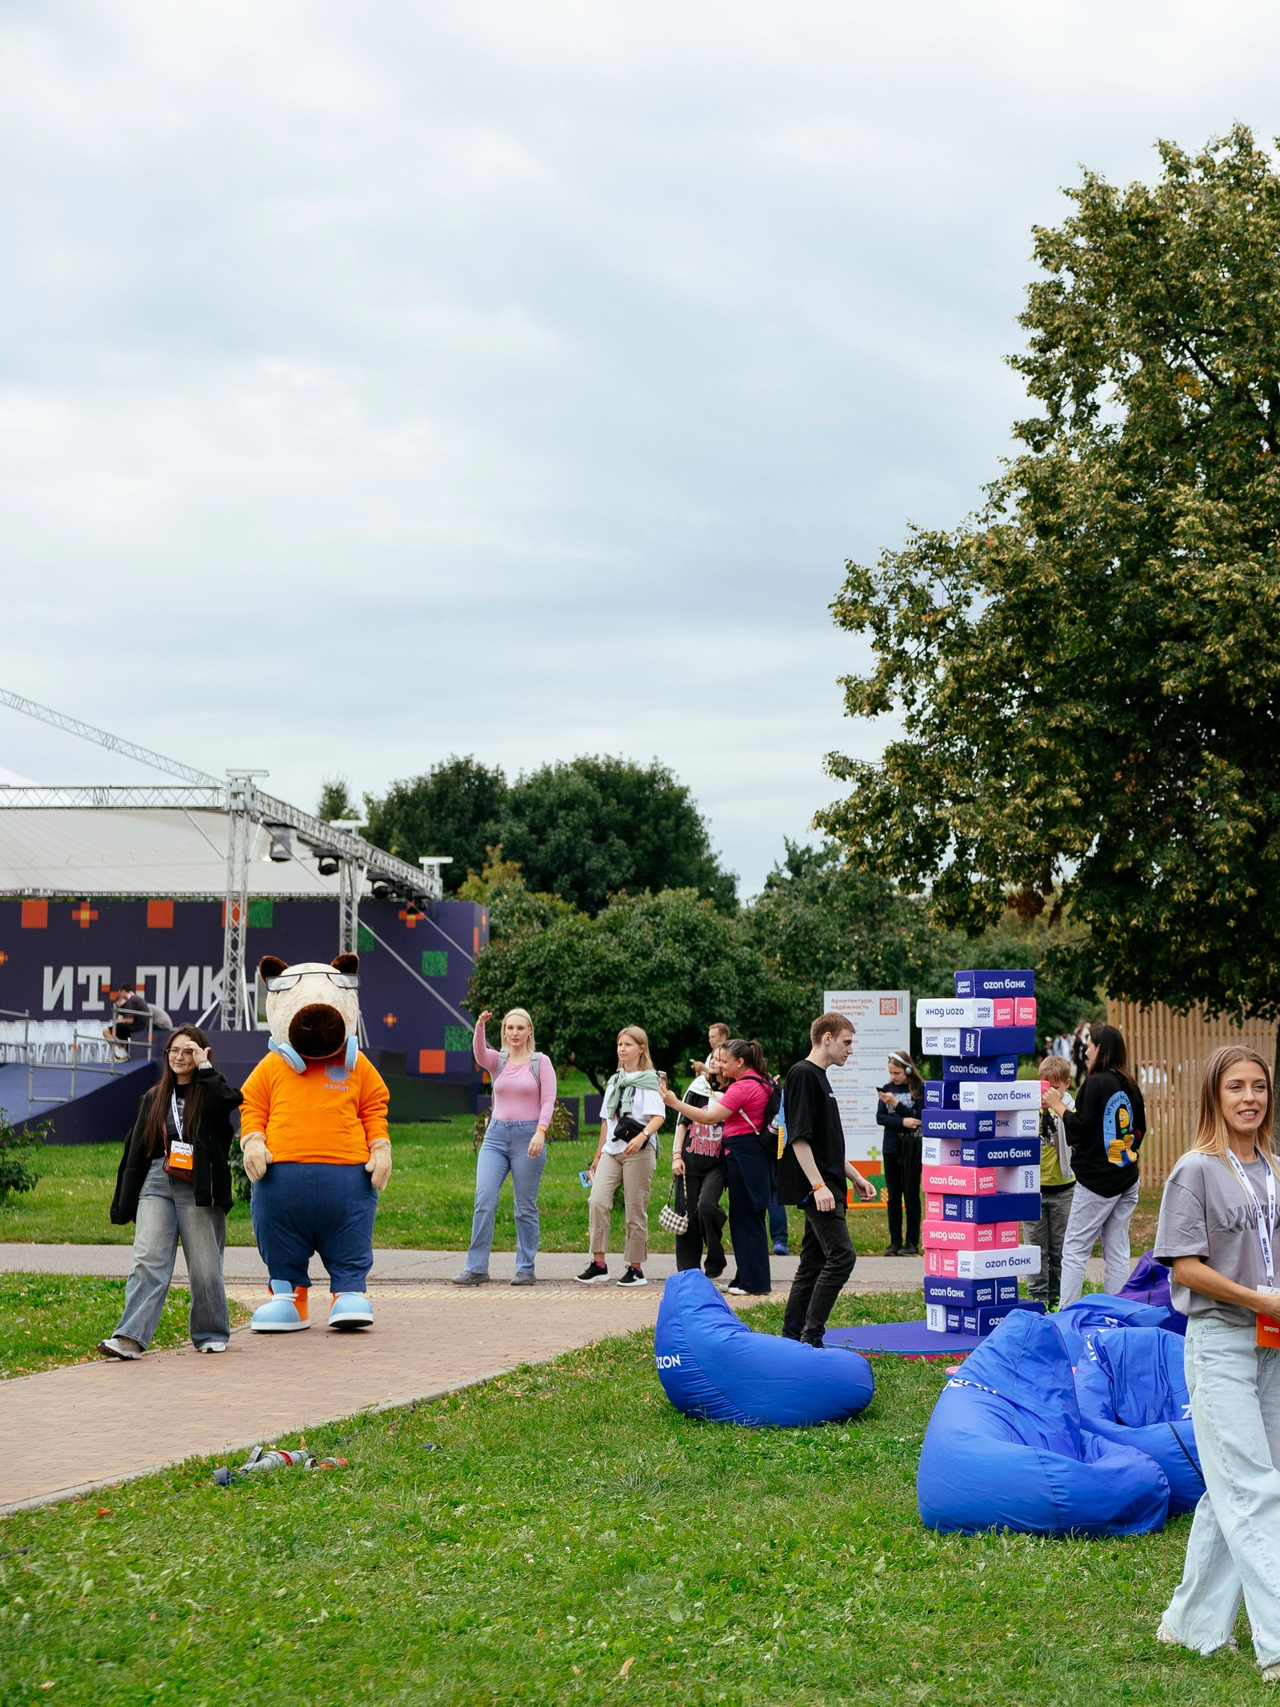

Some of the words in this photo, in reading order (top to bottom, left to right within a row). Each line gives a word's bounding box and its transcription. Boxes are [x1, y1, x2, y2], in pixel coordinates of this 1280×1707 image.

[984, 981, 1004, 989] ozon
[1005, 979, 1026, 988] банк
[926, 1008, 944, 1017] банк
[950, 1064, 968, 1073] ozon
[968, 1064, 988, 1074] банк
[988, 1092, 1008, 1100] ozon
[1010, 1091, 1031, 1100] банк
[928, 1121, 946, 1130] ozon
[947, 1120, 966, 1130] банк
[988, 1150, 1008, 1159] ozon
[1010, 1148, 1032, 1158] банк
[930, 1176, 948, 1185] ozon
[948, 1176, 966, 1187] банк
[930, 1231, 947, 1241] банк
[948, 1232, 966, 1240] ozon
[985, 1260, 1006, 1268] ozon
[1008, 1257, 1031, 1267] банк
[944, 1264, 954, 1272] банк
[930, 1288, 946, 1296] ozon
[946, 1287, 964, 1298] банк
[976, 1294, 992, 1302] банк
[948, 1320, 958, 1328] банк
[964, 1322, 976, 1330] банк
[1264, 1325, 1280, 1333] ПРОМО
[656, 1354, 681, 1369] ZON
